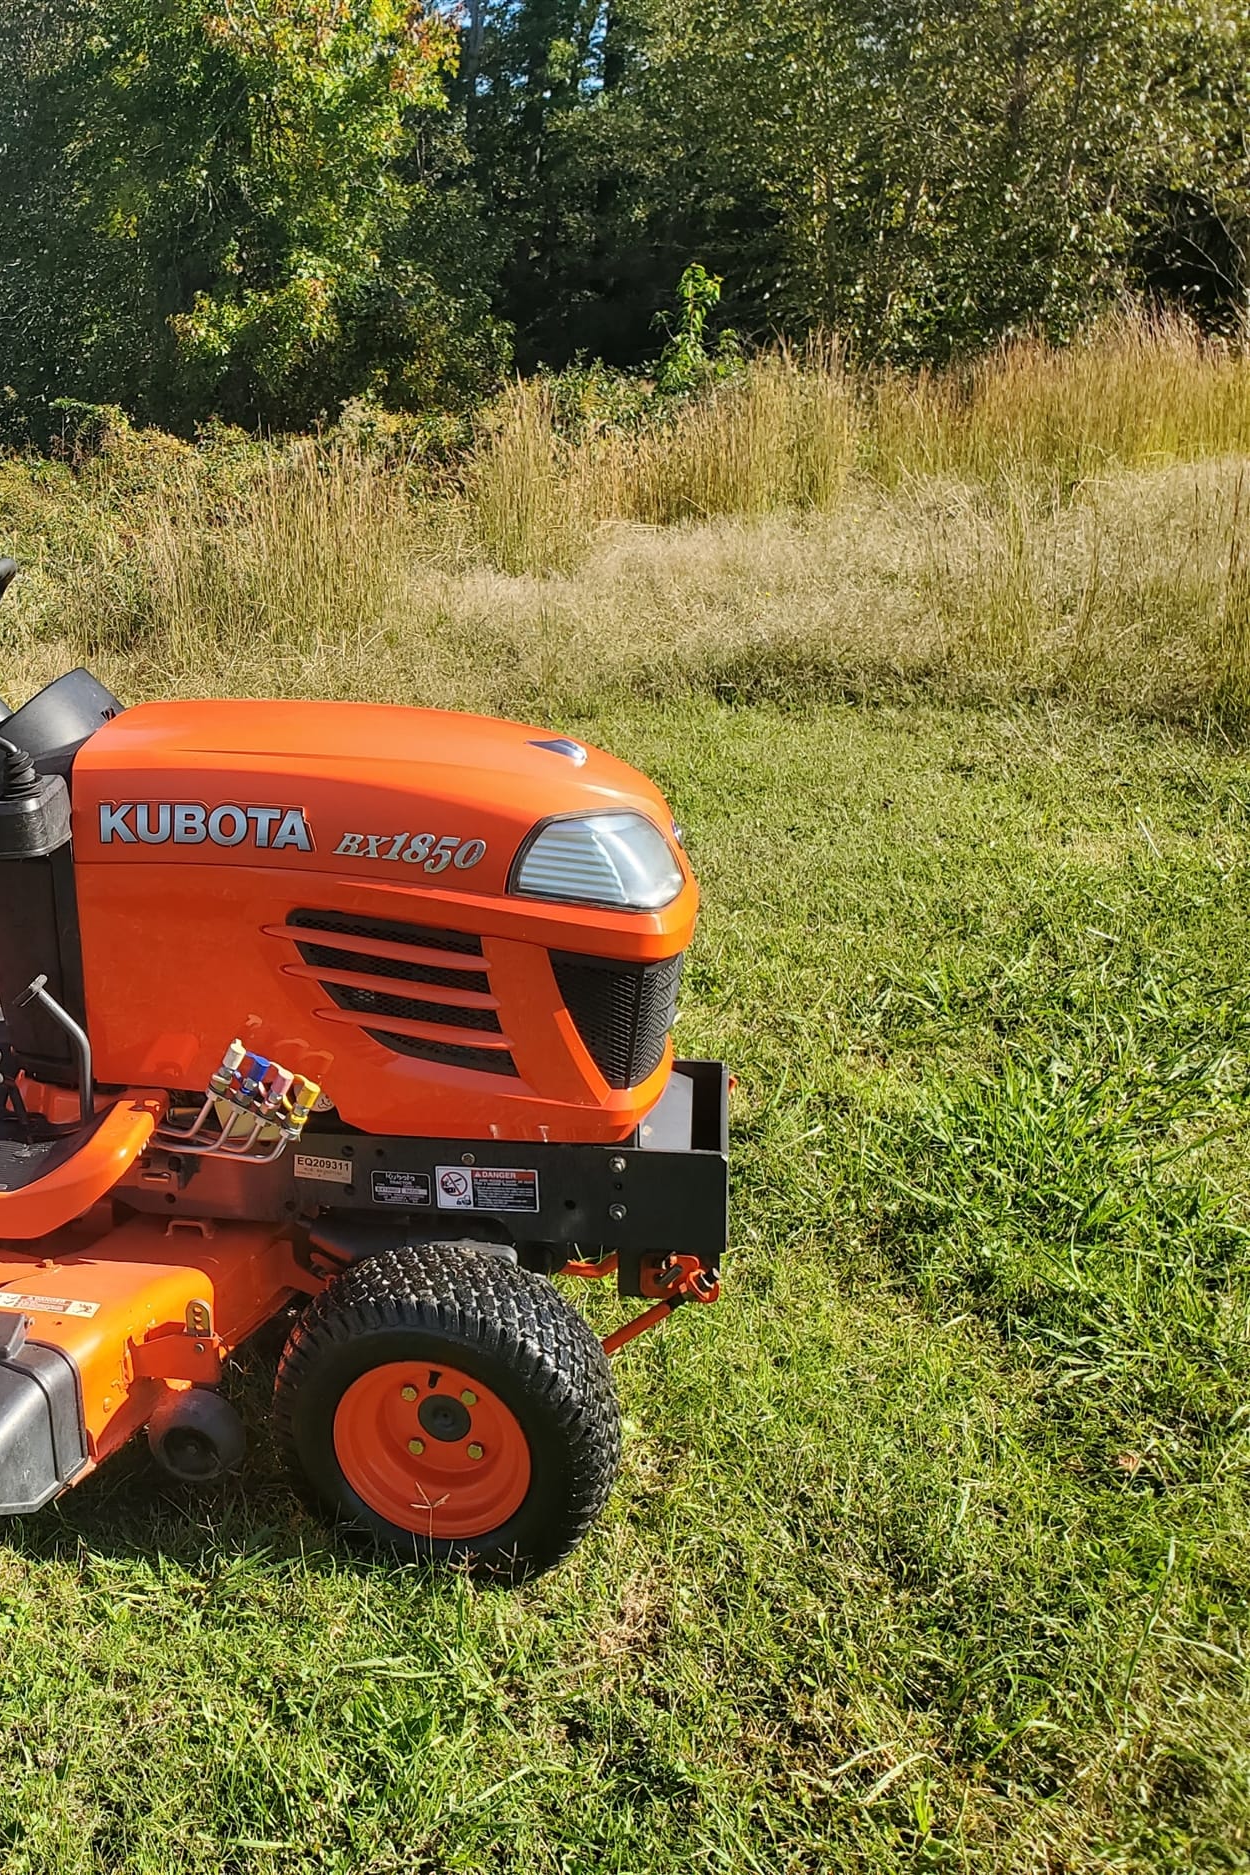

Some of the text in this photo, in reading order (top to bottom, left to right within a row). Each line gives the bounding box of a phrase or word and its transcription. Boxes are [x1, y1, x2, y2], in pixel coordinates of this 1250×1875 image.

[100, 804, 311, 851] KUBOTA
[332, 832, 487, 873] BX1850
[297, 1157, 349, 1171] EQ209311
[481, 1171, 517, 1179] DANGER
